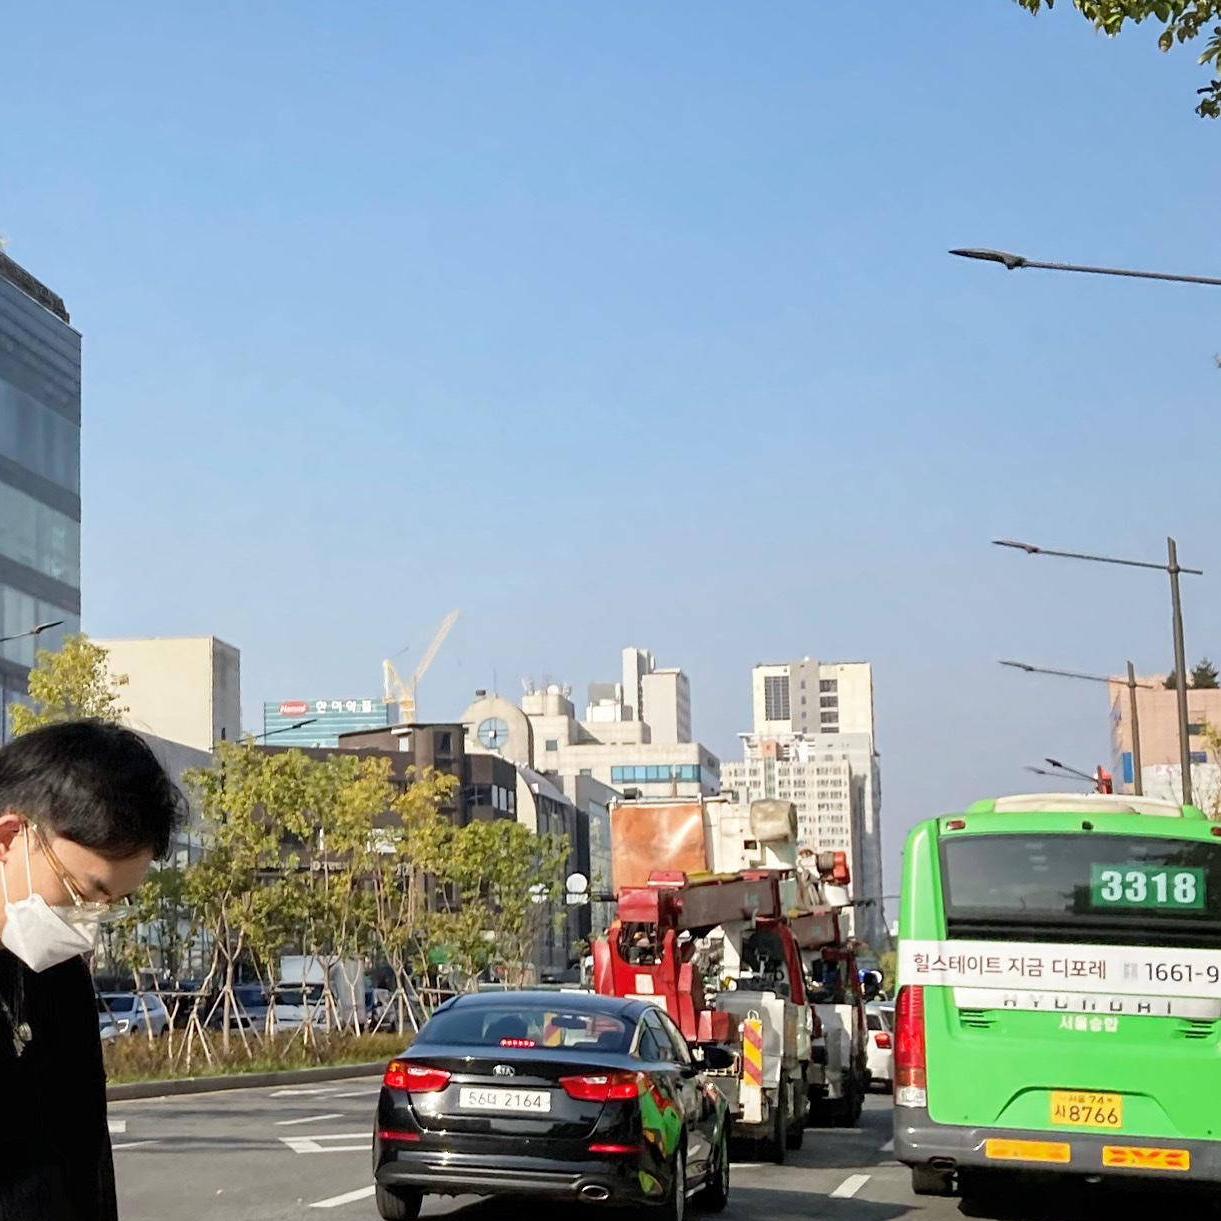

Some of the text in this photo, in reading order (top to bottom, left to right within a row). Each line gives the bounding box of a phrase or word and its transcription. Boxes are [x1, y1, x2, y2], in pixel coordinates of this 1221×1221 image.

[1100, 870, 1197, 904] 3318
[913, 952, 1003, 975] 힐스테이트
[1008, 957, 1045, 978] 지금
[1052, 959, 1107, 980] 디포레
[504, 1093, 542, 1108] 2164
